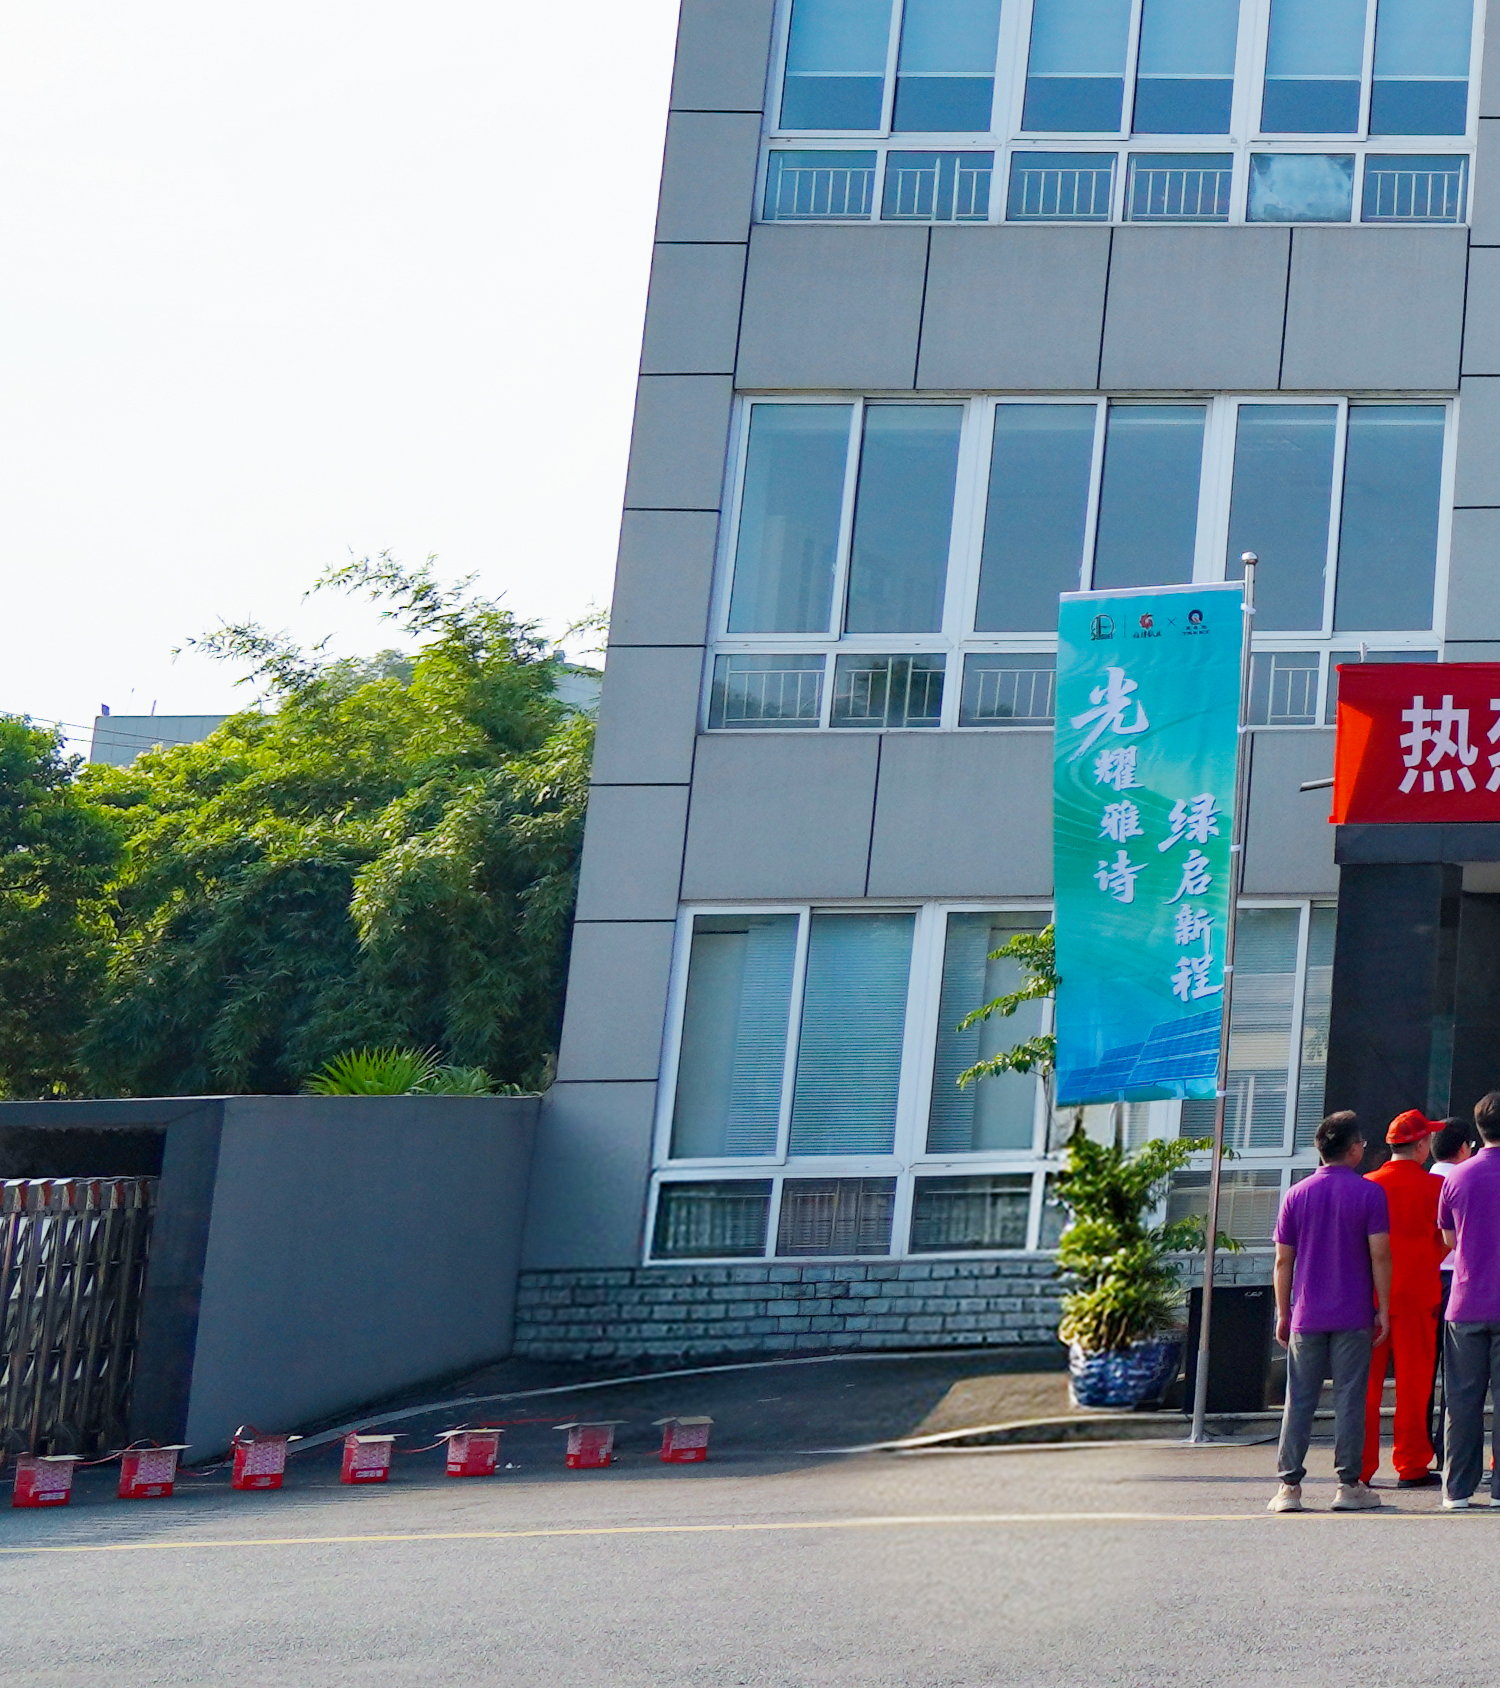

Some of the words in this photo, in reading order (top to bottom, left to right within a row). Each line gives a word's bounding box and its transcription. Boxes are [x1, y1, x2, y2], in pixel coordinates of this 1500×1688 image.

[1067, 665, 1150, 905] 光耀雅诗
[1156, 792, 1225, 1004] 绿启新程
